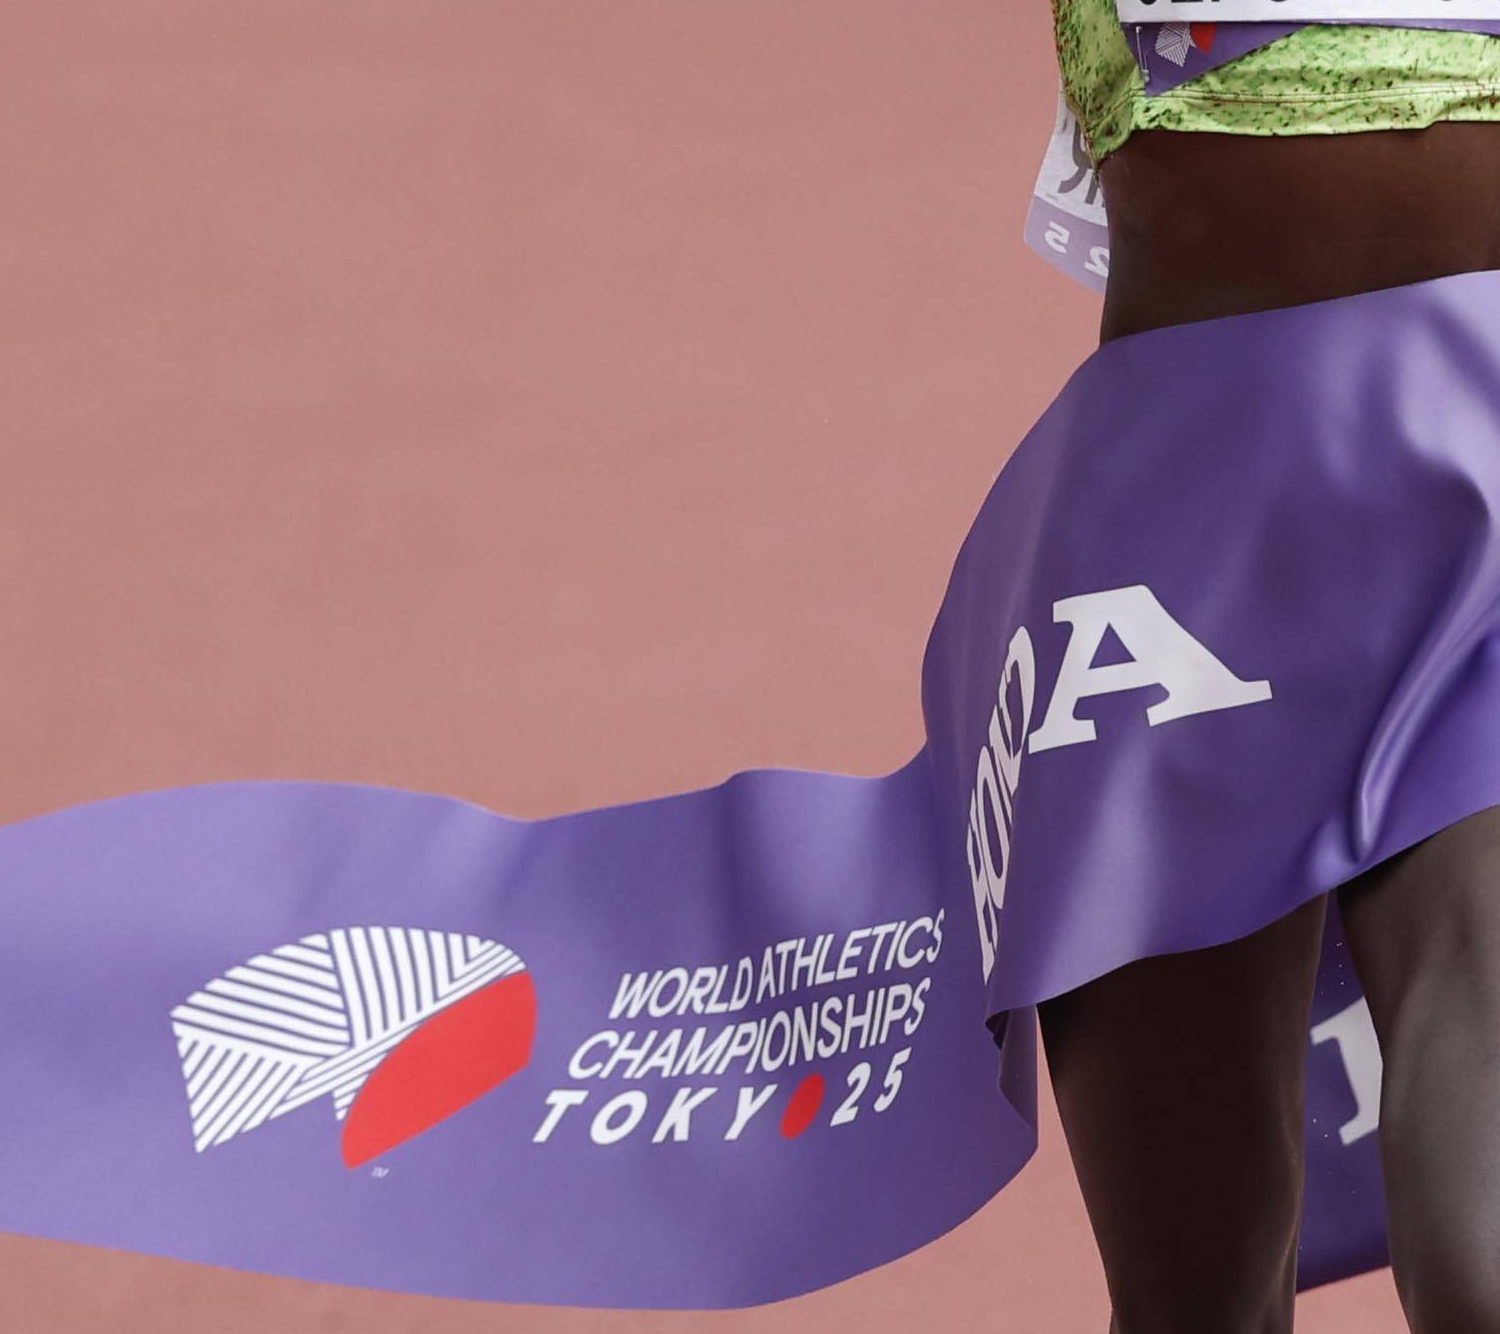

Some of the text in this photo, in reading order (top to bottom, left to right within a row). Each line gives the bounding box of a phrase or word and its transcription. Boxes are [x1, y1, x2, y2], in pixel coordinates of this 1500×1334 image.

[966, 584, 1273, 986] HONDA
[608, 907, 946, 1020] WORLD ATHLETICS
[568, 977, 932, 1080] CHAMPIONSHIPS
[830, 1047, 913, 1127] 25
